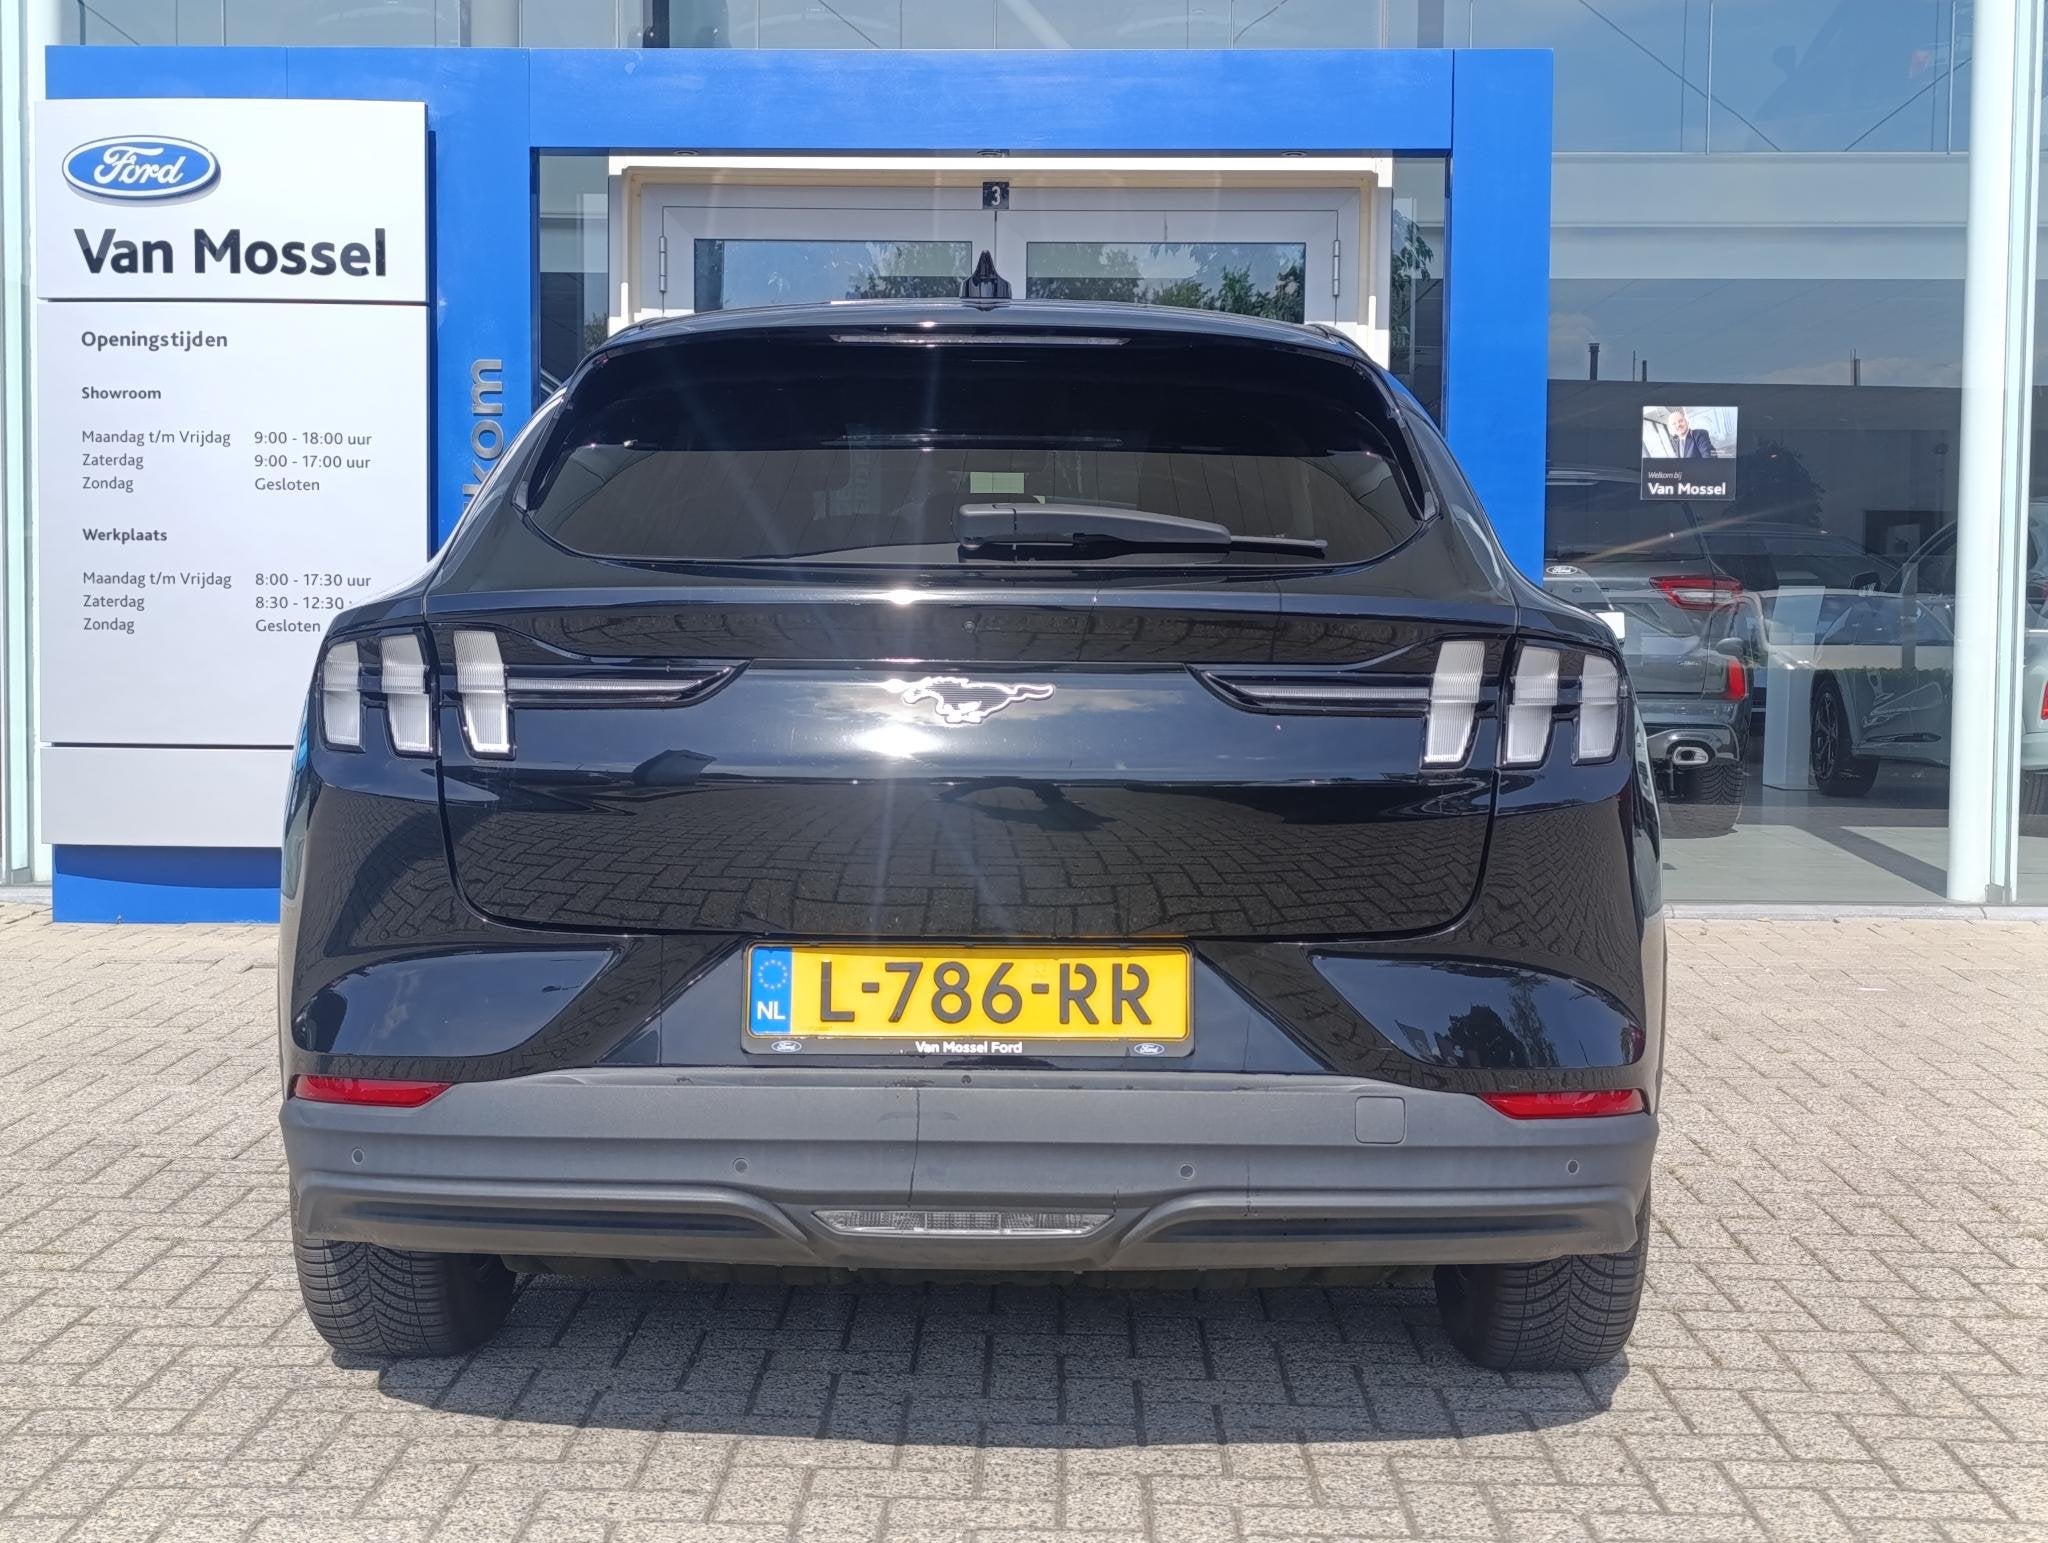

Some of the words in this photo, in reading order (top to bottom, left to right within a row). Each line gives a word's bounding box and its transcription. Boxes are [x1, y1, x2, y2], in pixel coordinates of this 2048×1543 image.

[93, 144, 188, 184] Ford
[990, 185, 1001, 206] 3
[74, 228, 174, 274] Van
[193, 227, 387, 277] Mossel
[81, 330, 228, 352] Openingstijden
[81, 385, 162, 400] Showroom
[81, 429, 145, 447] Maandag
[148, 429, 175, 444] t/m
[178, 430, 231, 448] Vrijdag
[254, 431, 288, 445] 9:00
[302, 431, 344, 445] 18:00
[347, 435, 372, 446] uur
[81, 452, 144, 470] Zaterdag
[254, 454, 288, 468] 9:00
[302, 455, 342, 469] 17:00
[346, 459, 371, 469] uur
[82, 475, 134, 493] Zondag
[254, 477, 320, 491] Gesloten
[1647, 482, 1674, 495] Van
[1677, 482, 1726, 495] Mossel
[82, 527, 168, 544] Werkplaats
[82, 571, 146, 589] Maandag
[149, 571, 176, 585] t/m
[179, 571, 232, 590] Vrijdag
[255, 572, 289, 586] 8:00
[303, 573, 343, 587] 17:30
[347, 577, 372, 587] uur
[82, 594, 145, 612] Zaterdag
[255, 596, 289, 609] 8:30
[302, 596, 344, 610] 12:30
[83, 616, 135, 635] Zondag
[255, 618, 321, 633] Gesloten
[819, 960, 1152, 1026] L-786-RR
[757, 1001, 786, 1020] NL
[915, 1040, 940, 1054] Van
[942, 1040, 988, 1054] Mossel
[991, 1041, 1023, 1054] Ford
